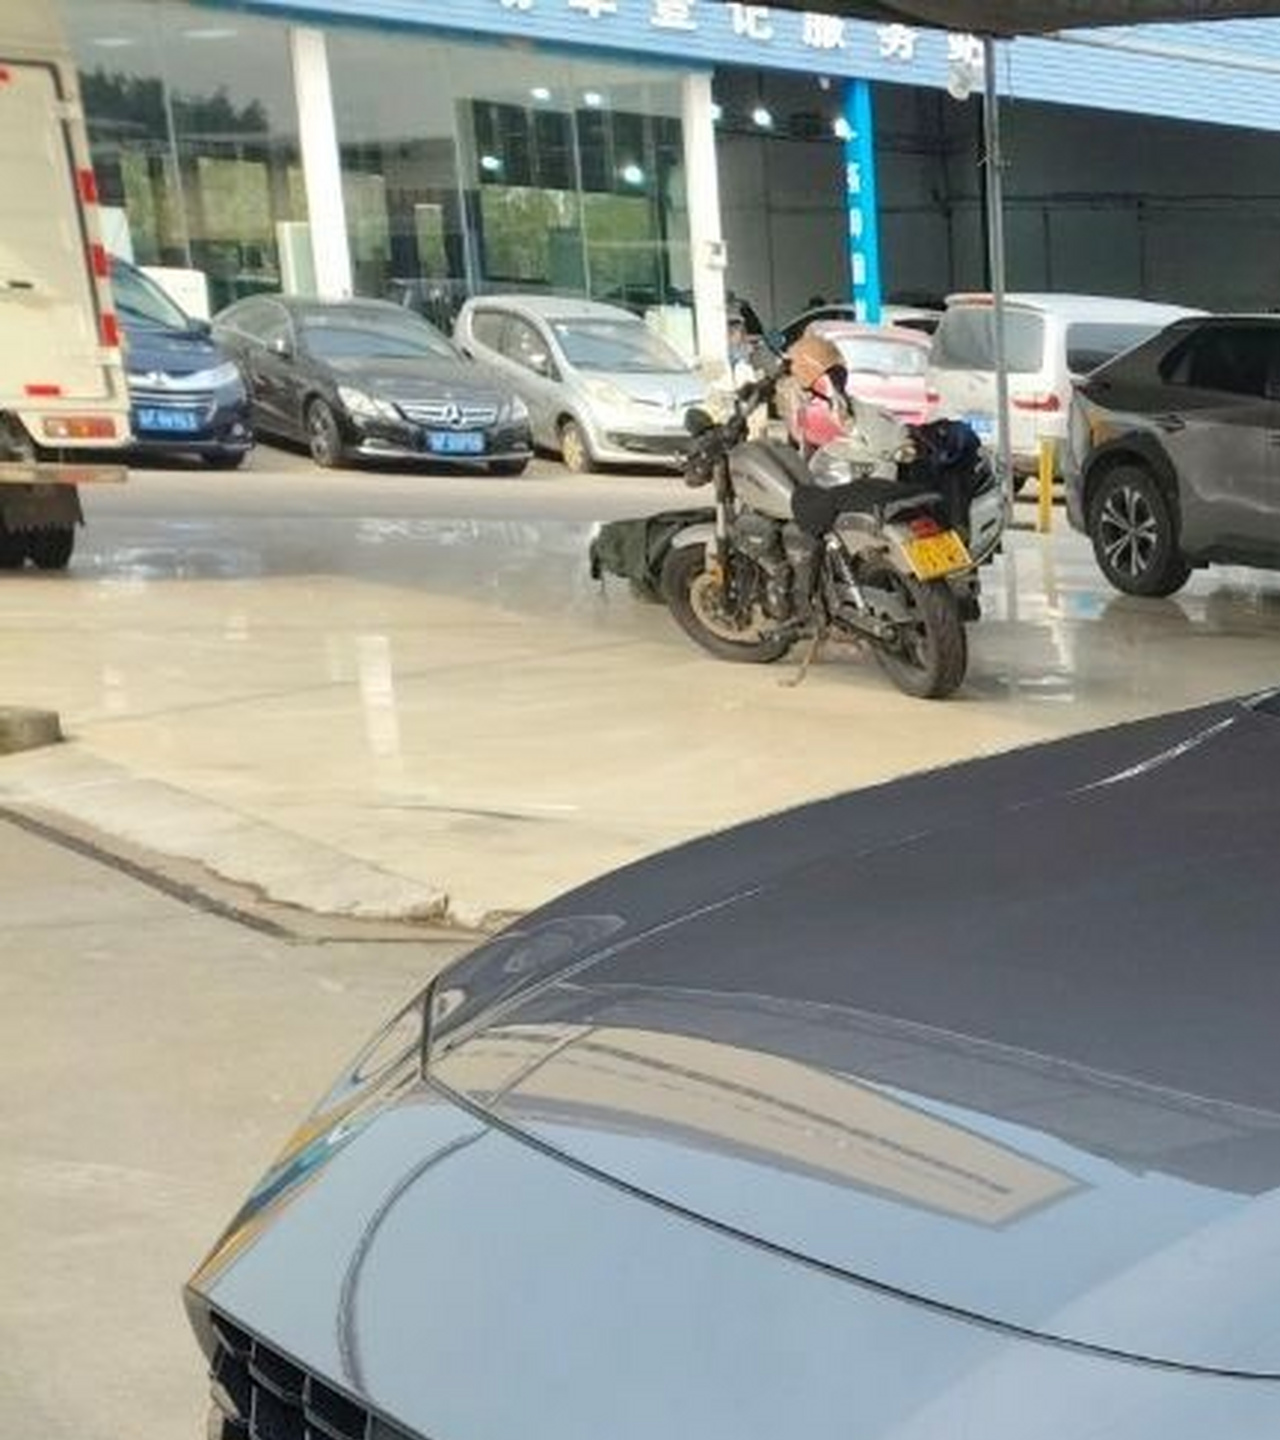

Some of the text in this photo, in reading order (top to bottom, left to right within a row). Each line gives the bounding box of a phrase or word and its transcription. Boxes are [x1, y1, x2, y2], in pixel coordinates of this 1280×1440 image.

[502, 0, 986, 67] 车登记服务站
